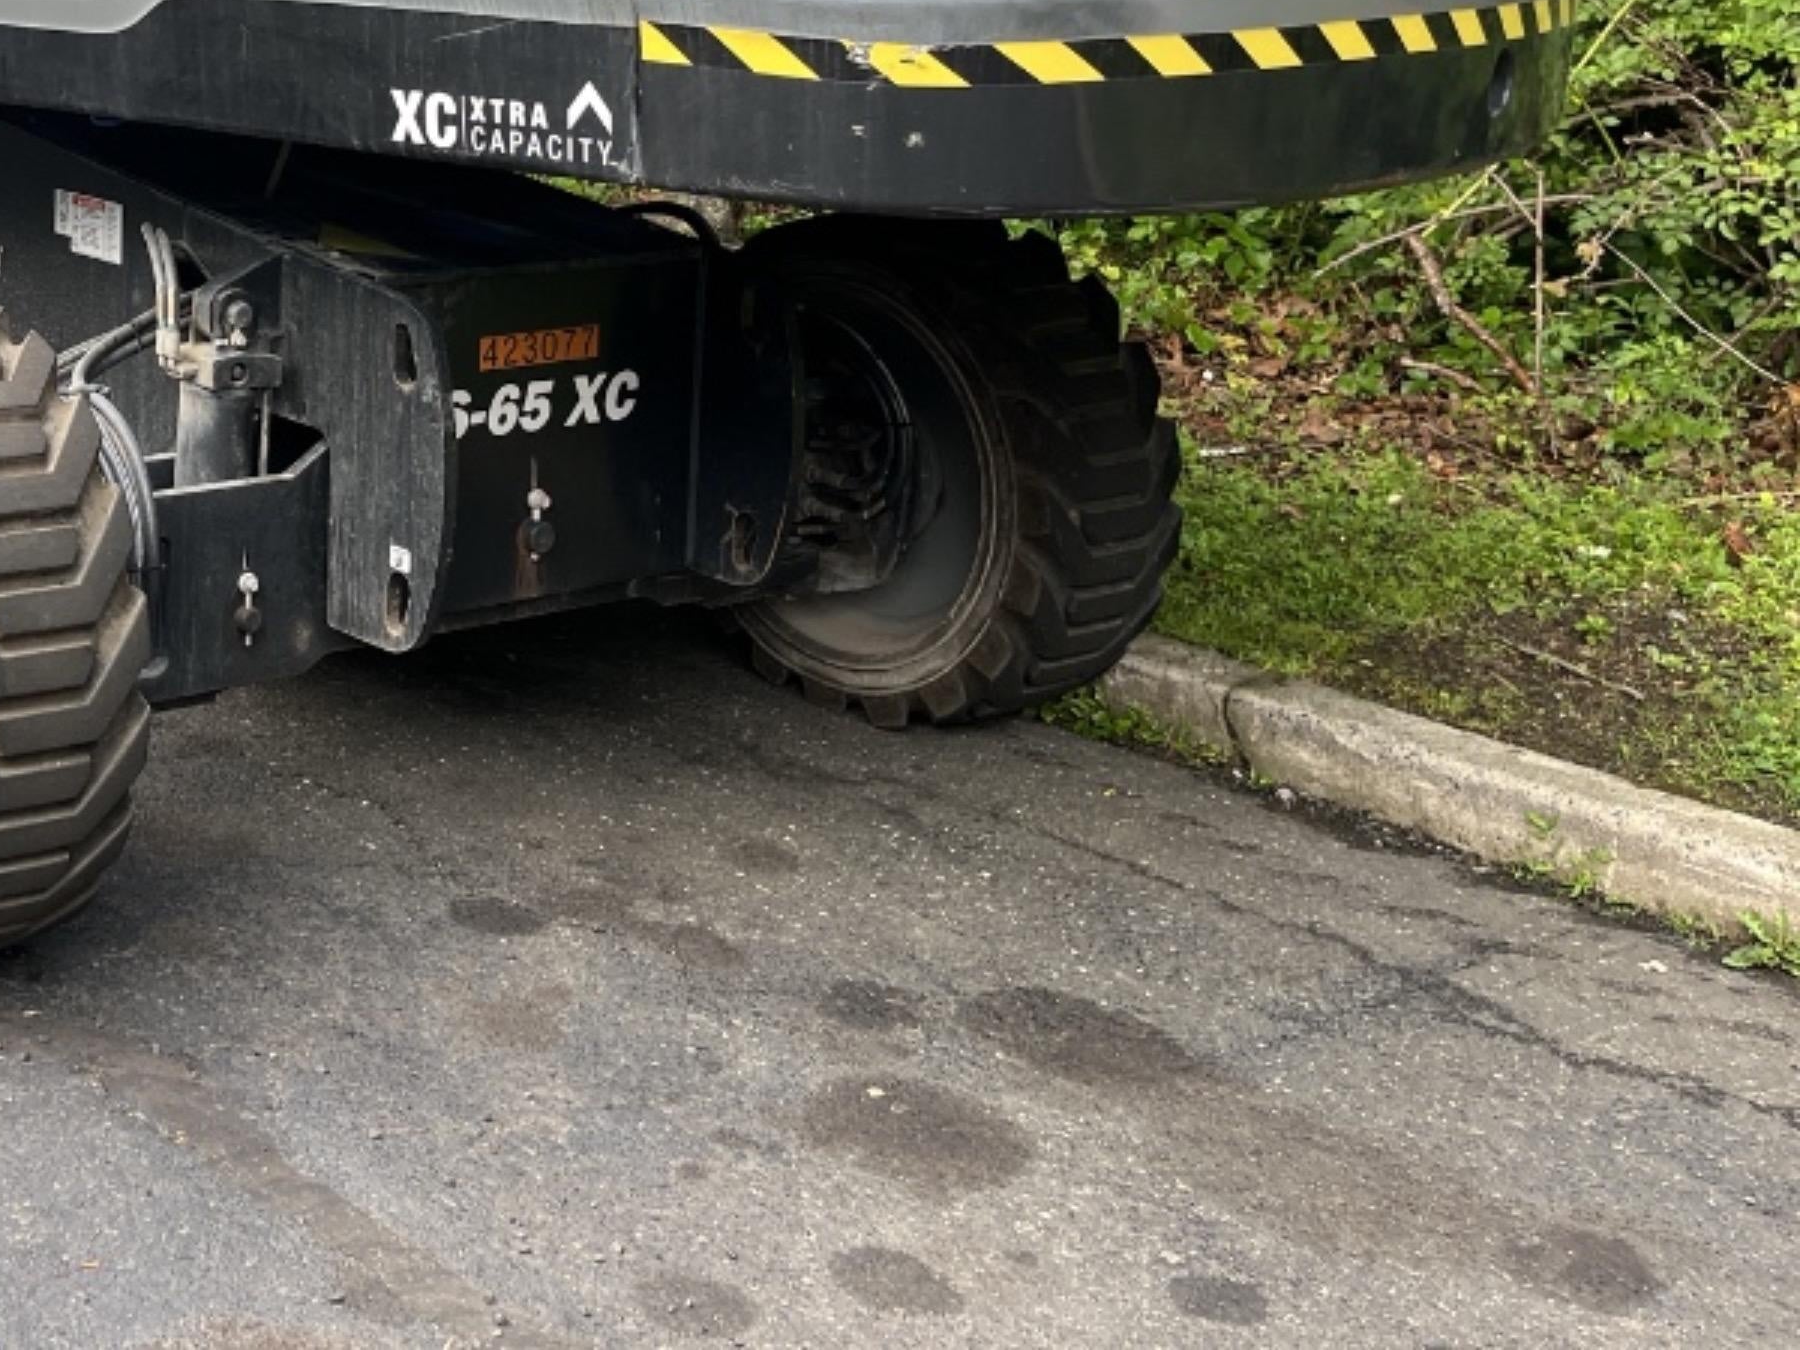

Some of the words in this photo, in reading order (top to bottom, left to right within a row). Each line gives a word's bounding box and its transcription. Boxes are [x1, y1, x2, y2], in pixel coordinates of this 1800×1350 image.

[389, 88, 458, 149] XC
[470, 95, 549, 130] XTRA
[470, 125, 613, 166] CAPACITY
[482, 324, 596, 367] 423077
[563, 368, 640, 427] XC
